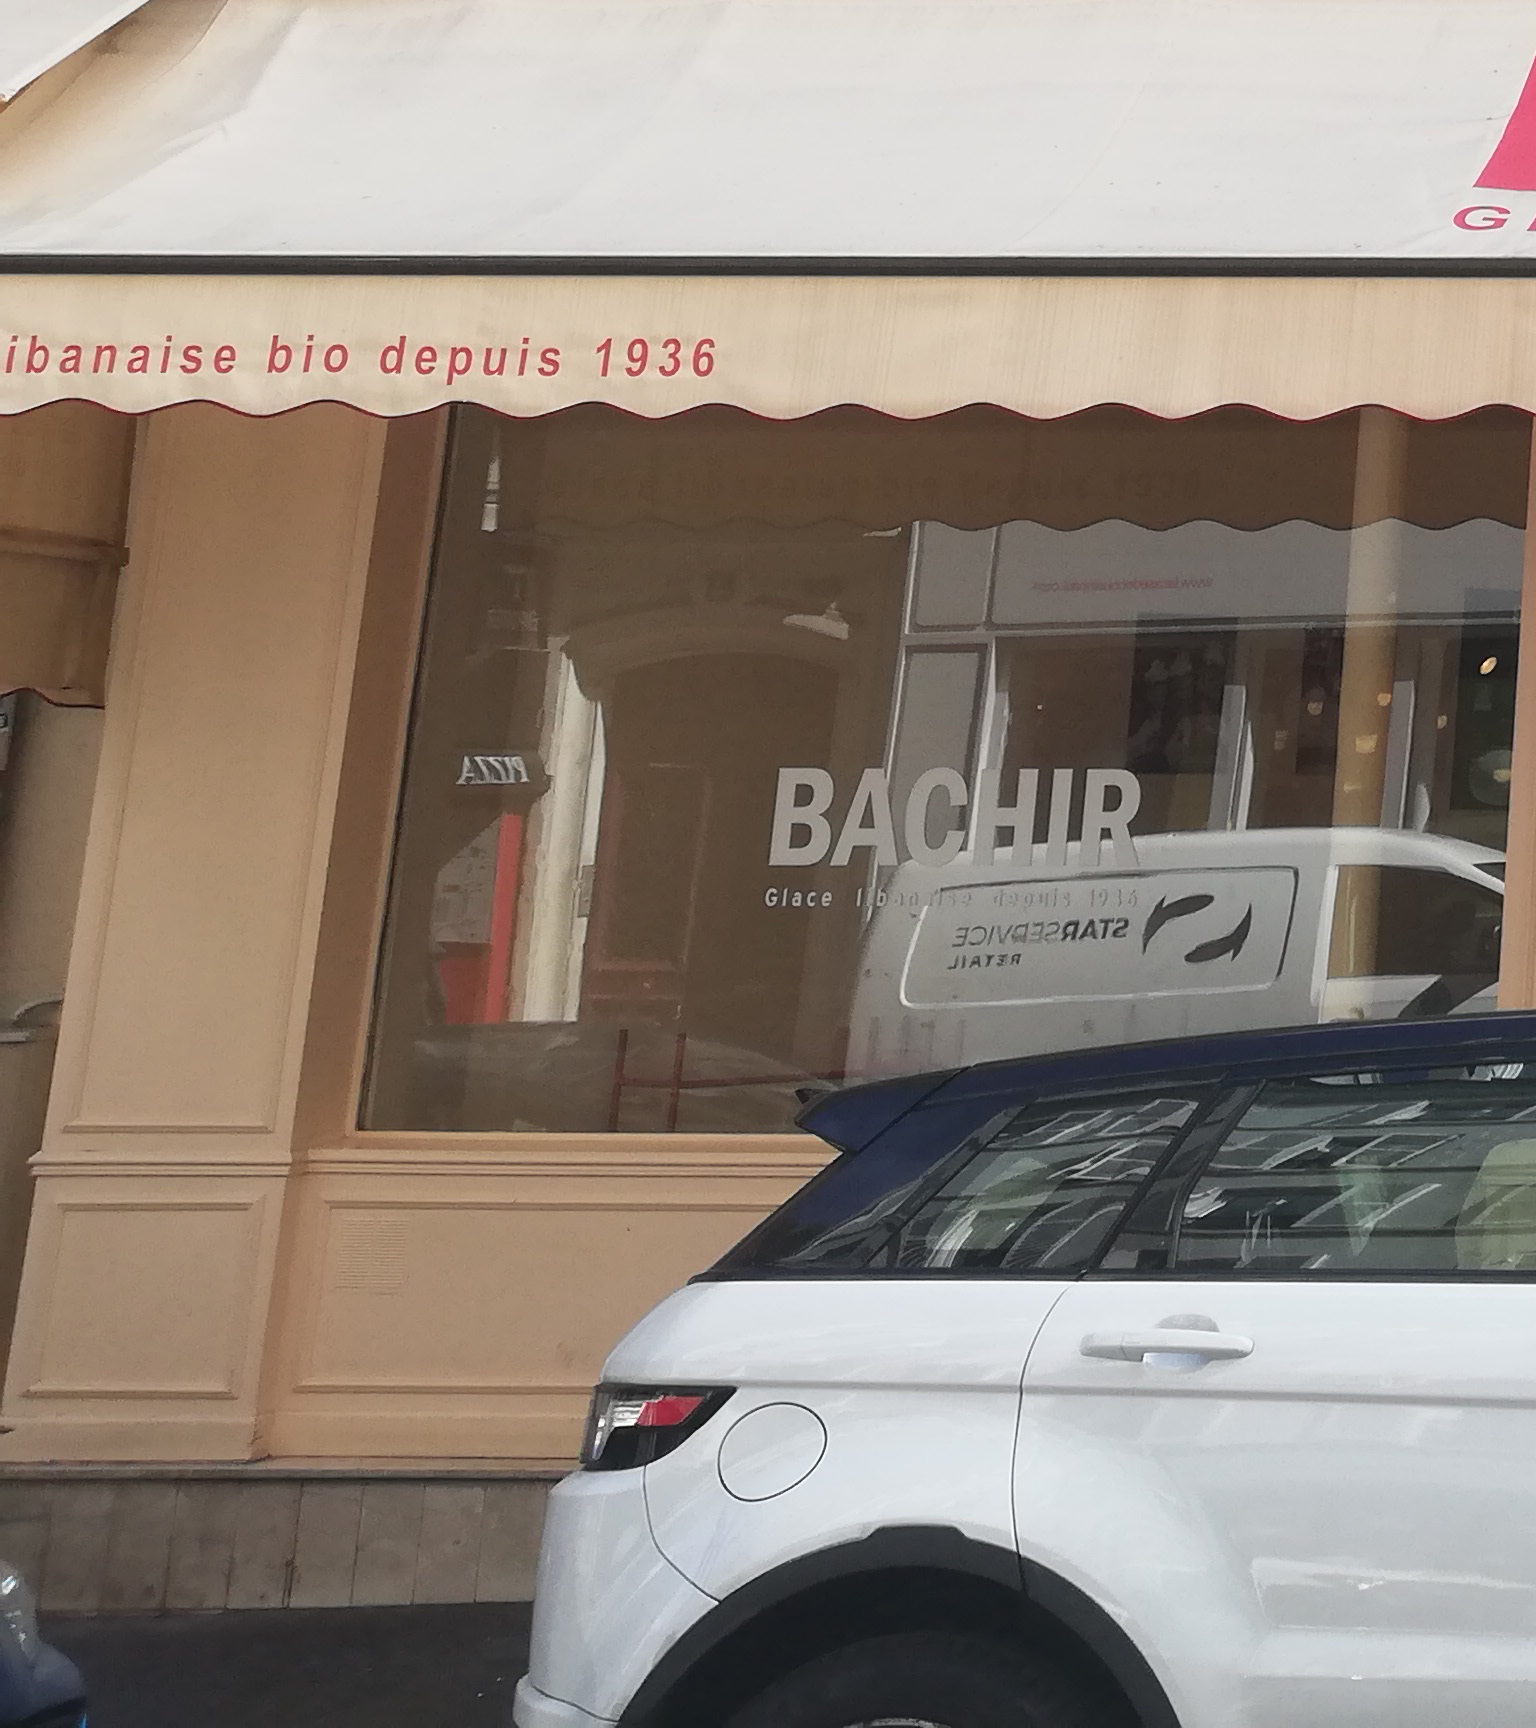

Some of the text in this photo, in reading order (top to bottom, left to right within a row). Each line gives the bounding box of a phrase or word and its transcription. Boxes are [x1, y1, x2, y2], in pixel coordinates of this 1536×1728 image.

[267, 334, 349, 374] bio
[379, 334, 562, 385] depuis
[596, 337, 716, 378] 1936
[768, 767, 1142, 868] BACHIR
[764, 887, 833, 908] Glace
